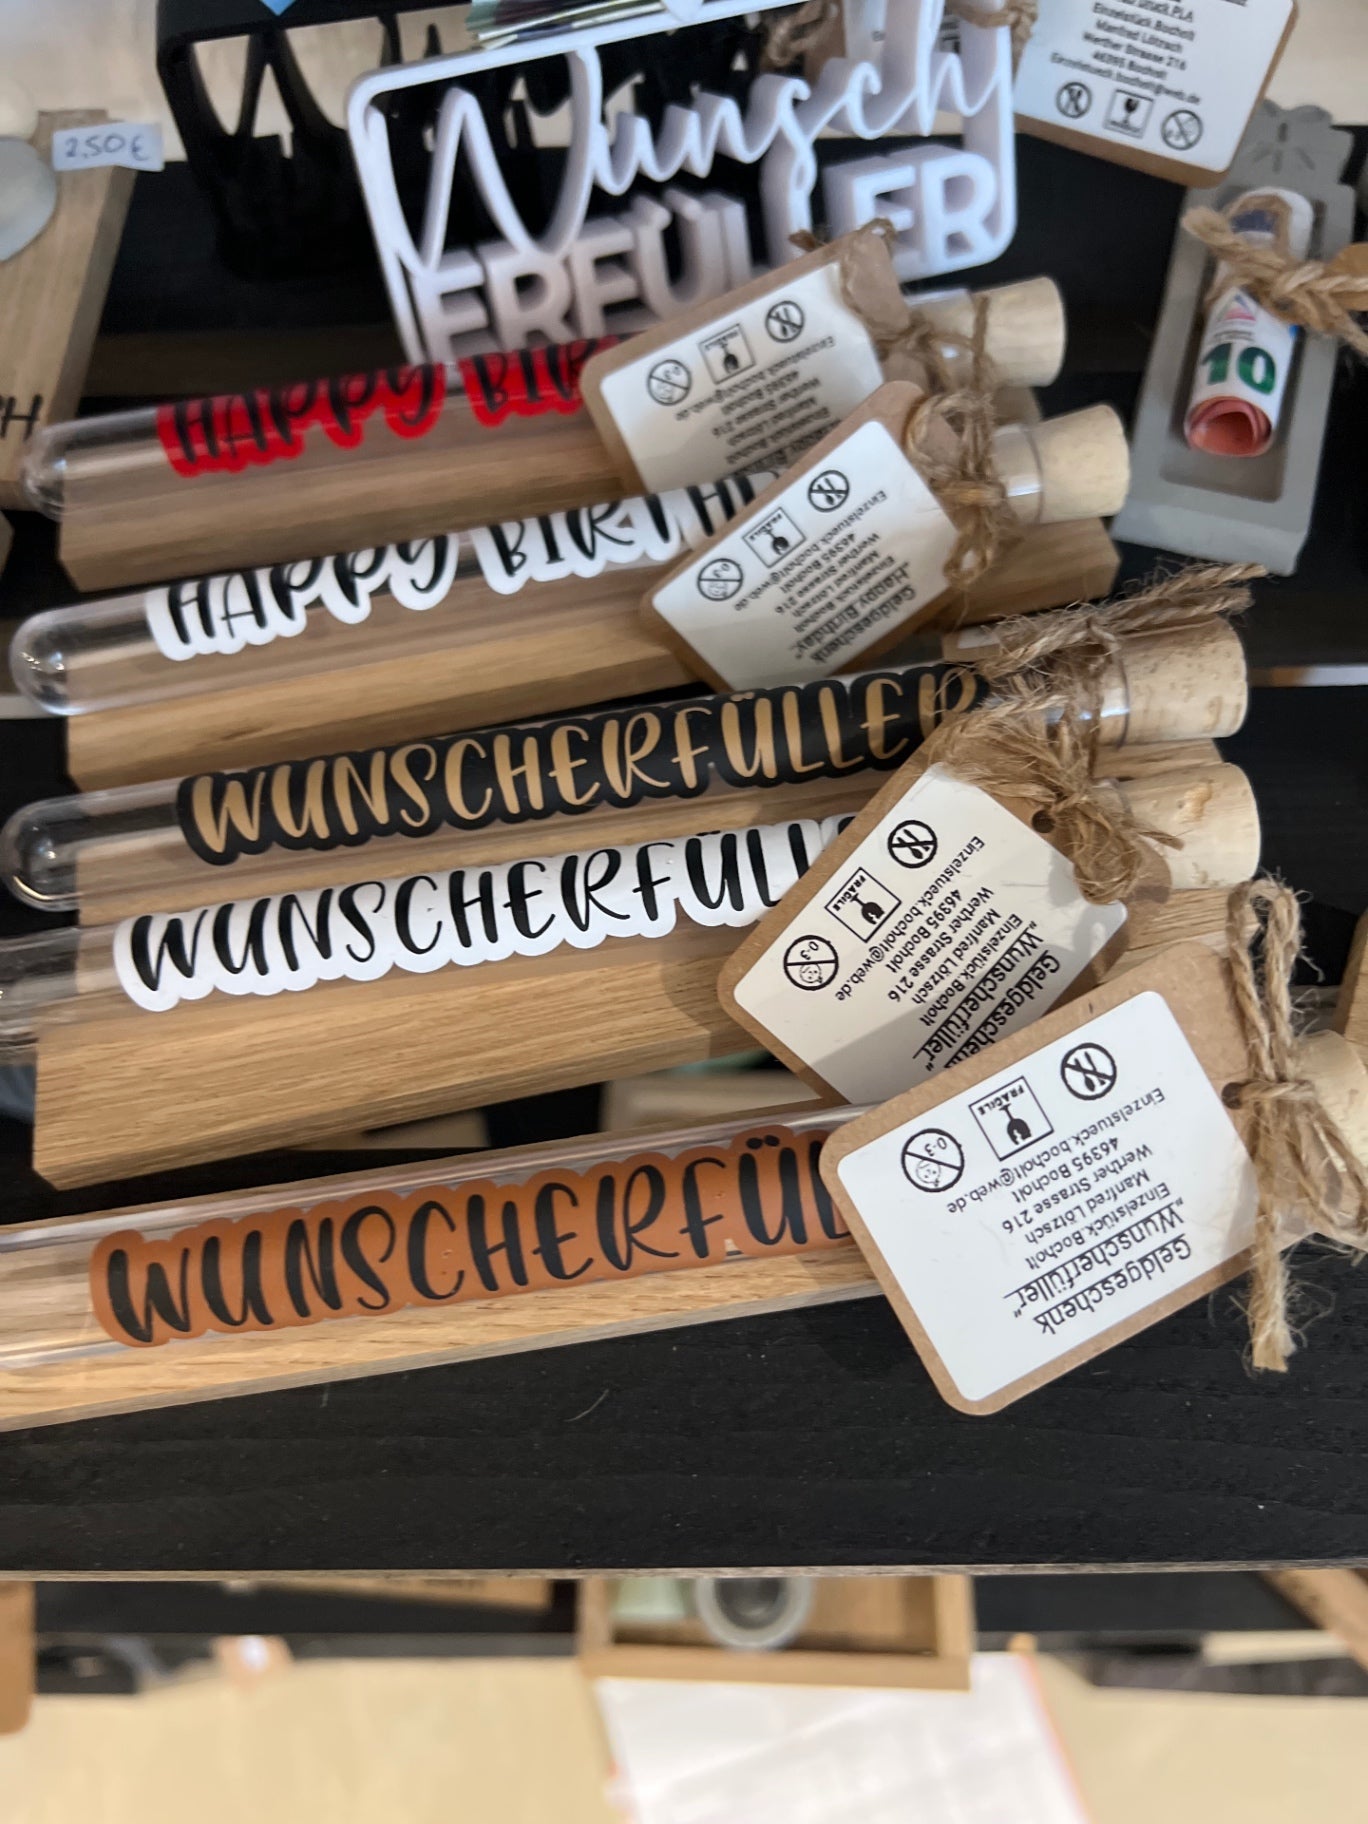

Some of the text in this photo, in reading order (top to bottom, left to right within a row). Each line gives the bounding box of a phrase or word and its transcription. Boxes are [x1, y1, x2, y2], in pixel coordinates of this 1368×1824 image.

[362, 0, 1002, 272] Wunsch
[472, 333, 640, 412] BIR
[1202, 342, 1277, 395] 10
[169, 470, 783, 646] HAPPY BIRTH
[774, 596, 797, 613] 216
[192, 666, 978, 854] WUNSCHERFÜLLER
[131, 817, 858, 991] WUNSCHERFÜLL
[832, 874, 866, 911] FRAGILE
[834, 835, 985, 1000] Einzelstueck.bocholt@web.de
[884, 889, 962, 973] 46395 Bocholt
[887, 886, 994, 1002] Werther Strasse 216
[911, 907, 1001, 1004] Manfred Lötzsch
[943, 949, 1060, 1068] Geldgeschen
[977, 1084, 1024, 1115] FRAGILE
[946, 1087, 1165, 1213] Einzelstueck.bocholt@web.de
[1001, 1143, 1152, 1234] Werther Strasse 216
[1011, 1137, 1117, 1203] 46395 Bocholt
[106, 1134, 851, 1343] WUNSCHERFÜL
[1024, 1168, 1150, 1244] Manfred Lötzsch
[1032, 1232, 1191, 1334] Geldgeschenk
